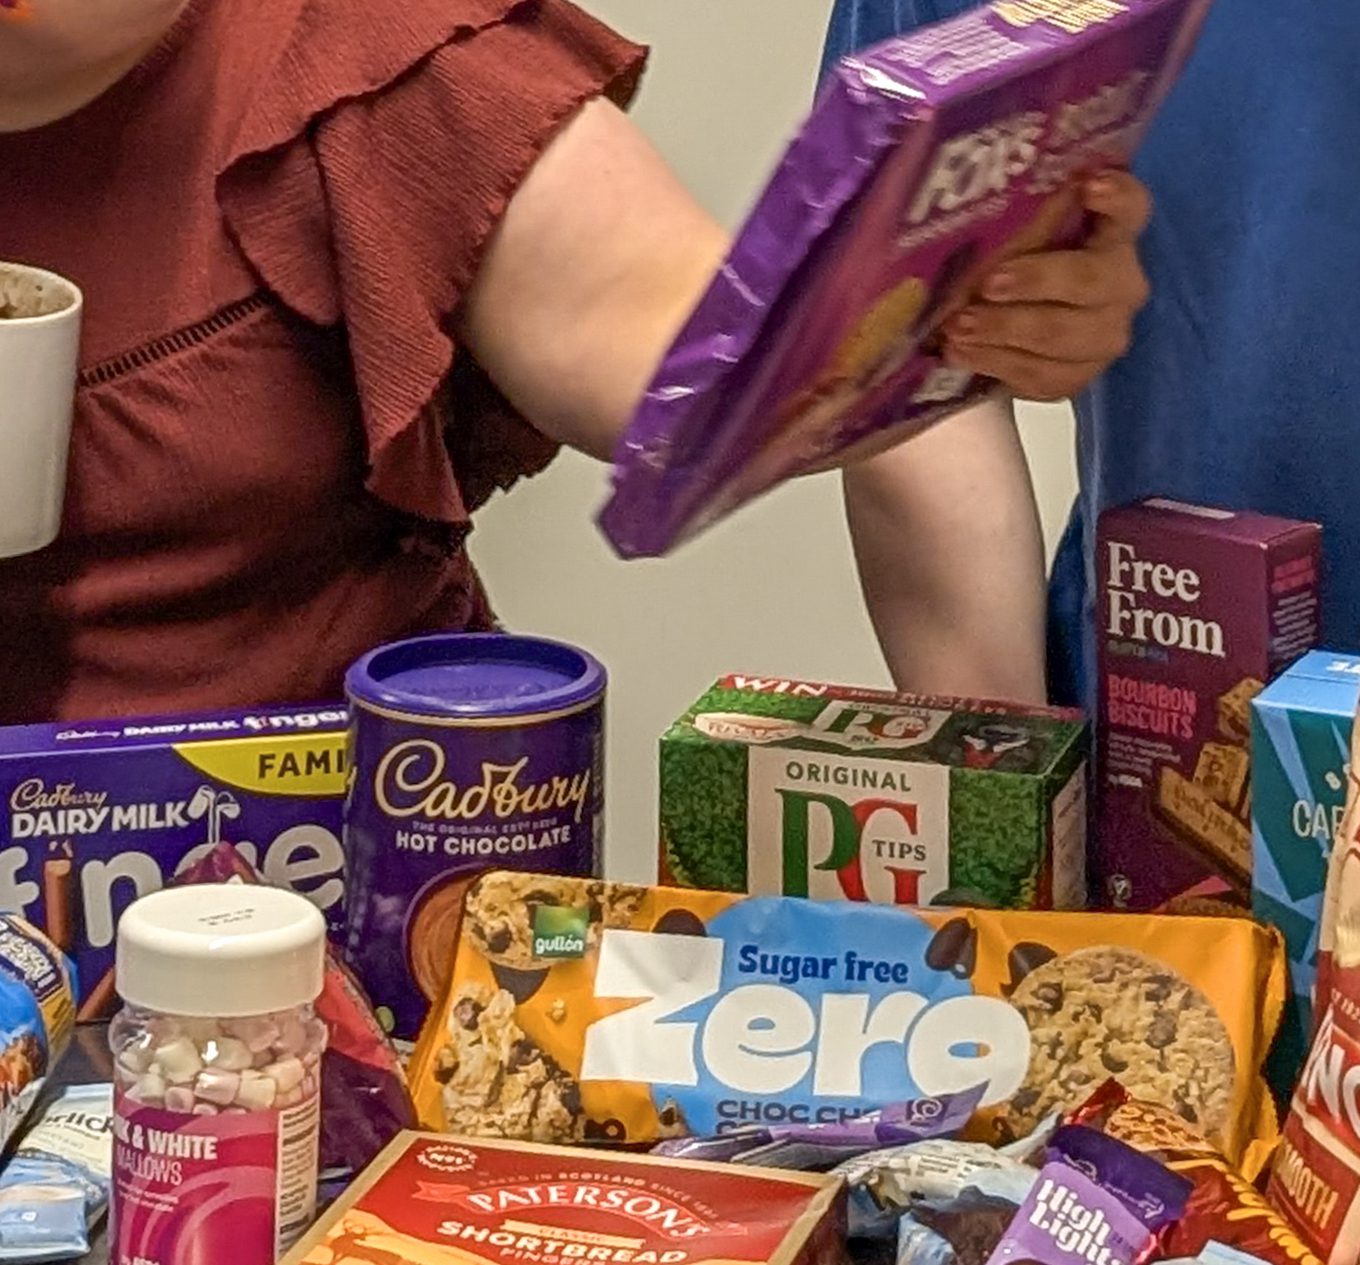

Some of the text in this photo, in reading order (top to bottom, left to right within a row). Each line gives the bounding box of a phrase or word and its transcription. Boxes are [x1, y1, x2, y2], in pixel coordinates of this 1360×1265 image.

[1107, 540, 1201, 603] Free
[1107, 587, 1226, 658] From
[732, 675, 829, 697] WIN
[1108, 673, 1197, 716] BOURBON
[124, 723, 187, 737] DAIRY
[189, 719, 240, 732] MILK
[1108, 698, 1194, 740] BISCUITS
[9, 778, 108, 812] Cadbury
[374, 738, 591, 823] Cadbury
[786, 760, 912, 792] ORIGINAL
[11, 799, 191, 839] DAIRY MILK
[395, 824, 572, 855] HOT CHOCOLATE
[774, 788, 927, 905] PG
[871, 839, 927, 862] TIPS
[535, 936, 585, 956] gullón
[738, 945, 910, 984] Sugar free
[579, 928, 1031, 1107] Zero
[716, 1099, 810, 1124] CHOC
[132, 1124, 144, 1149] &
[147, 1129, 218, 1160] WHITE
[558, 1172, 646, 1187] SCOTLAND
[1036, 1178, 1113, 1248] High
[436, 1221, 687, 1264] SHORTBREAD
